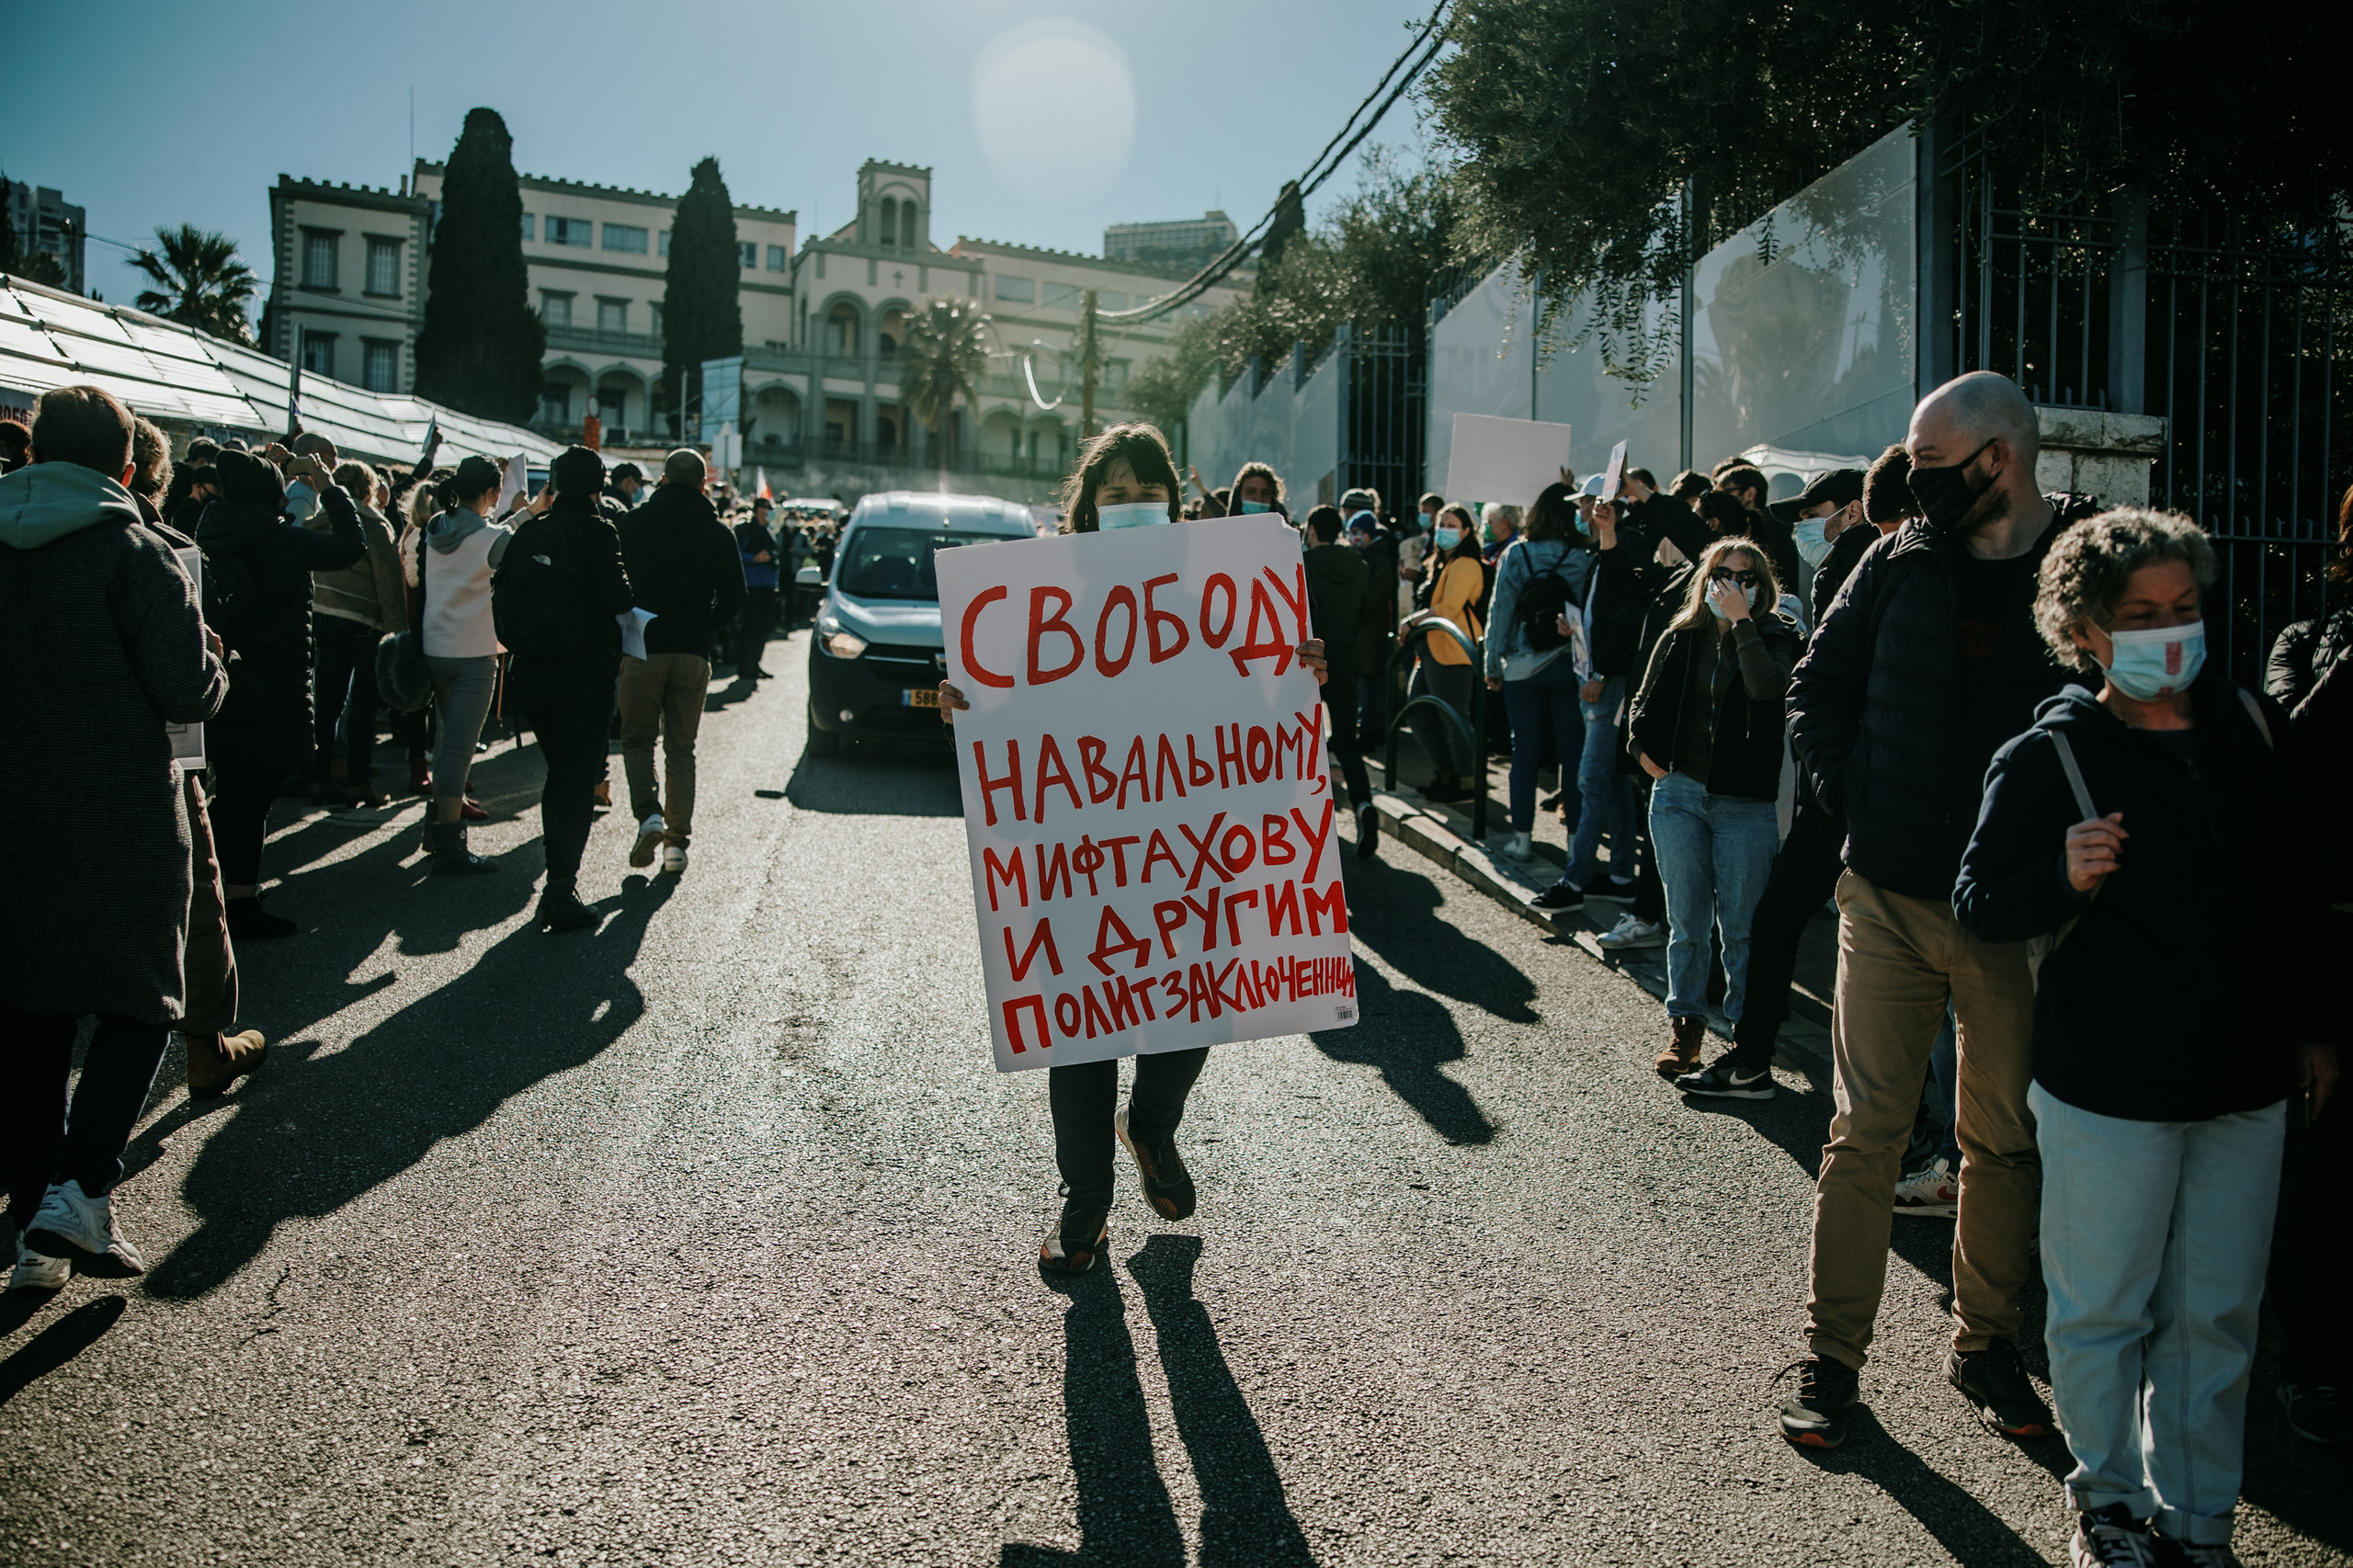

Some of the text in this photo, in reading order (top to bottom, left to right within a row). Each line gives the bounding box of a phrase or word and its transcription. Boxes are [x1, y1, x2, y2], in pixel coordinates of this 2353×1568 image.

[960, 562, 1308, 688] СВОБОДУ
[915, 690, 938, 705] 588
[972, 702, 1327, 827] НАВАЛЬНОМУ,
[983, 798, 1335, 912] МИФТАХОВУ
[1003, 880, 1349, 983] И ДРУГИМ
[1002, 955, 1356, 1054] ПОЛИТЗАКЛЮЧЕННЫМ
